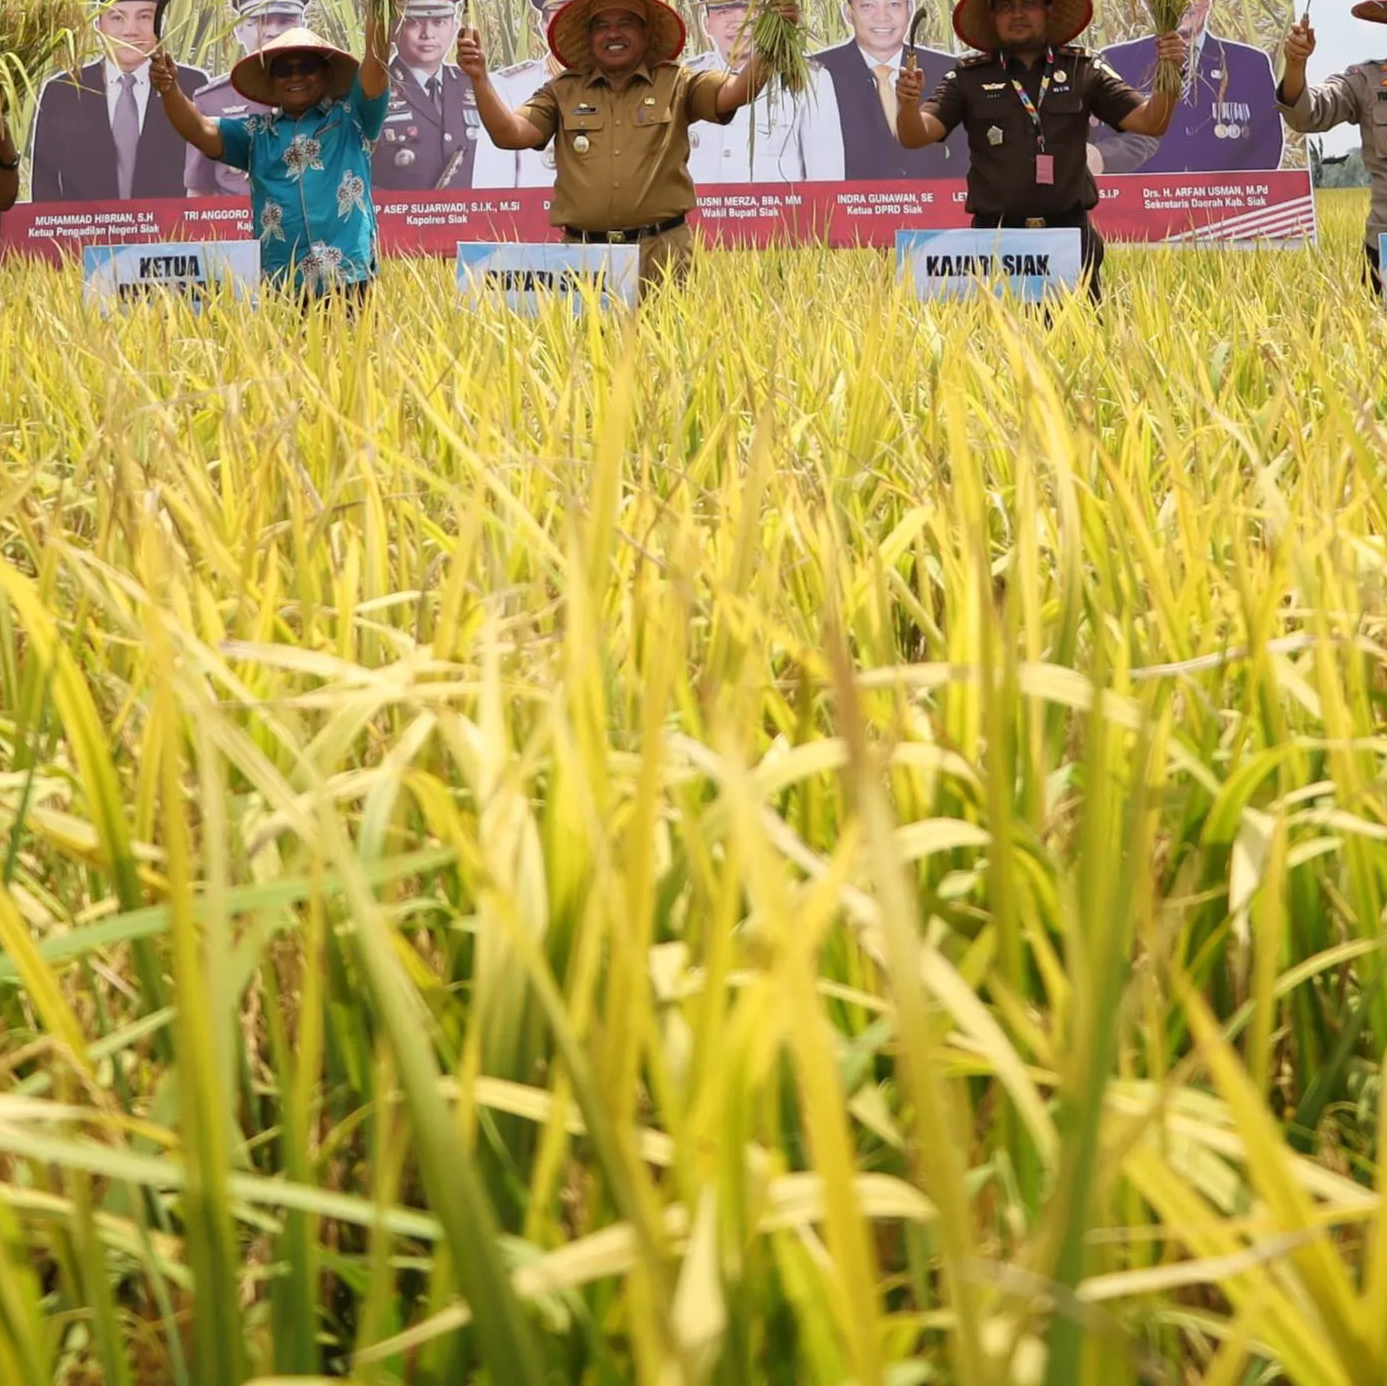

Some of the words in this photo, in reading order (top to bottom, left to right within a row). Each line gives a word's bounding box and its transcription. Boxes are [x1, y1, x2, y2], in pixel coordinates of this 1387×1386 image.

[1143, 188, 1159, 198] Drs.
[1163, 188, 1173, 197] H.
[1175, 186, 1206, 197] ARFAN
[1208, 186, 1244, 197] USMAN,
[1246, 185, 1269, 195] M.Pd
[724, 196, 759, 207] MERZA,
[785, 195, 802, 205] MM
[837, 194, 866, 204] INDRA
[868, 193, 919, 204] GUNAWAN,
[921, 193, 933, 202] SE
[1144, 198, 1189, 209] Sekretaris
[1191, 197, 1223, 208] Daerah
[1225, 197, 1245, 207] Kab.
[1246, 196, 1267, 206] Siak
[184, 211, 199, 220] TRI
[201, 209, 249, 220] ANGGORO
[384, 204, 408, 214] ASEP
[410, 202, 469, 214] SUJARWADI,
[701, 208, 726, 217] Wakil
[728, 207, 757, 219] Bupati
[759, 207, 779, 217] Siak
[846, 205, 872, 215] Ketua
[874, 205, 901, 214] DPRD
[902, 204, 923, 214] Siak
[35, 215, 92, 225] MUHAMMAD
[94, 213, 135, 224] HIBRIAN,
[137, 212, 154, 222] S.H
[406, 214, 445, 226] Kapolres
[447, 213, 468, 224] Siak
[28, 227, 54, 237] Ketua
[56, 225, 106, 238] Pengadilan
[109, 224, 138, 236] Negeri
[140, 223, 160, 233] Siak
[140, 255, 200, 278] KETUA
[1002, 254, 1050, 276] SIAK
